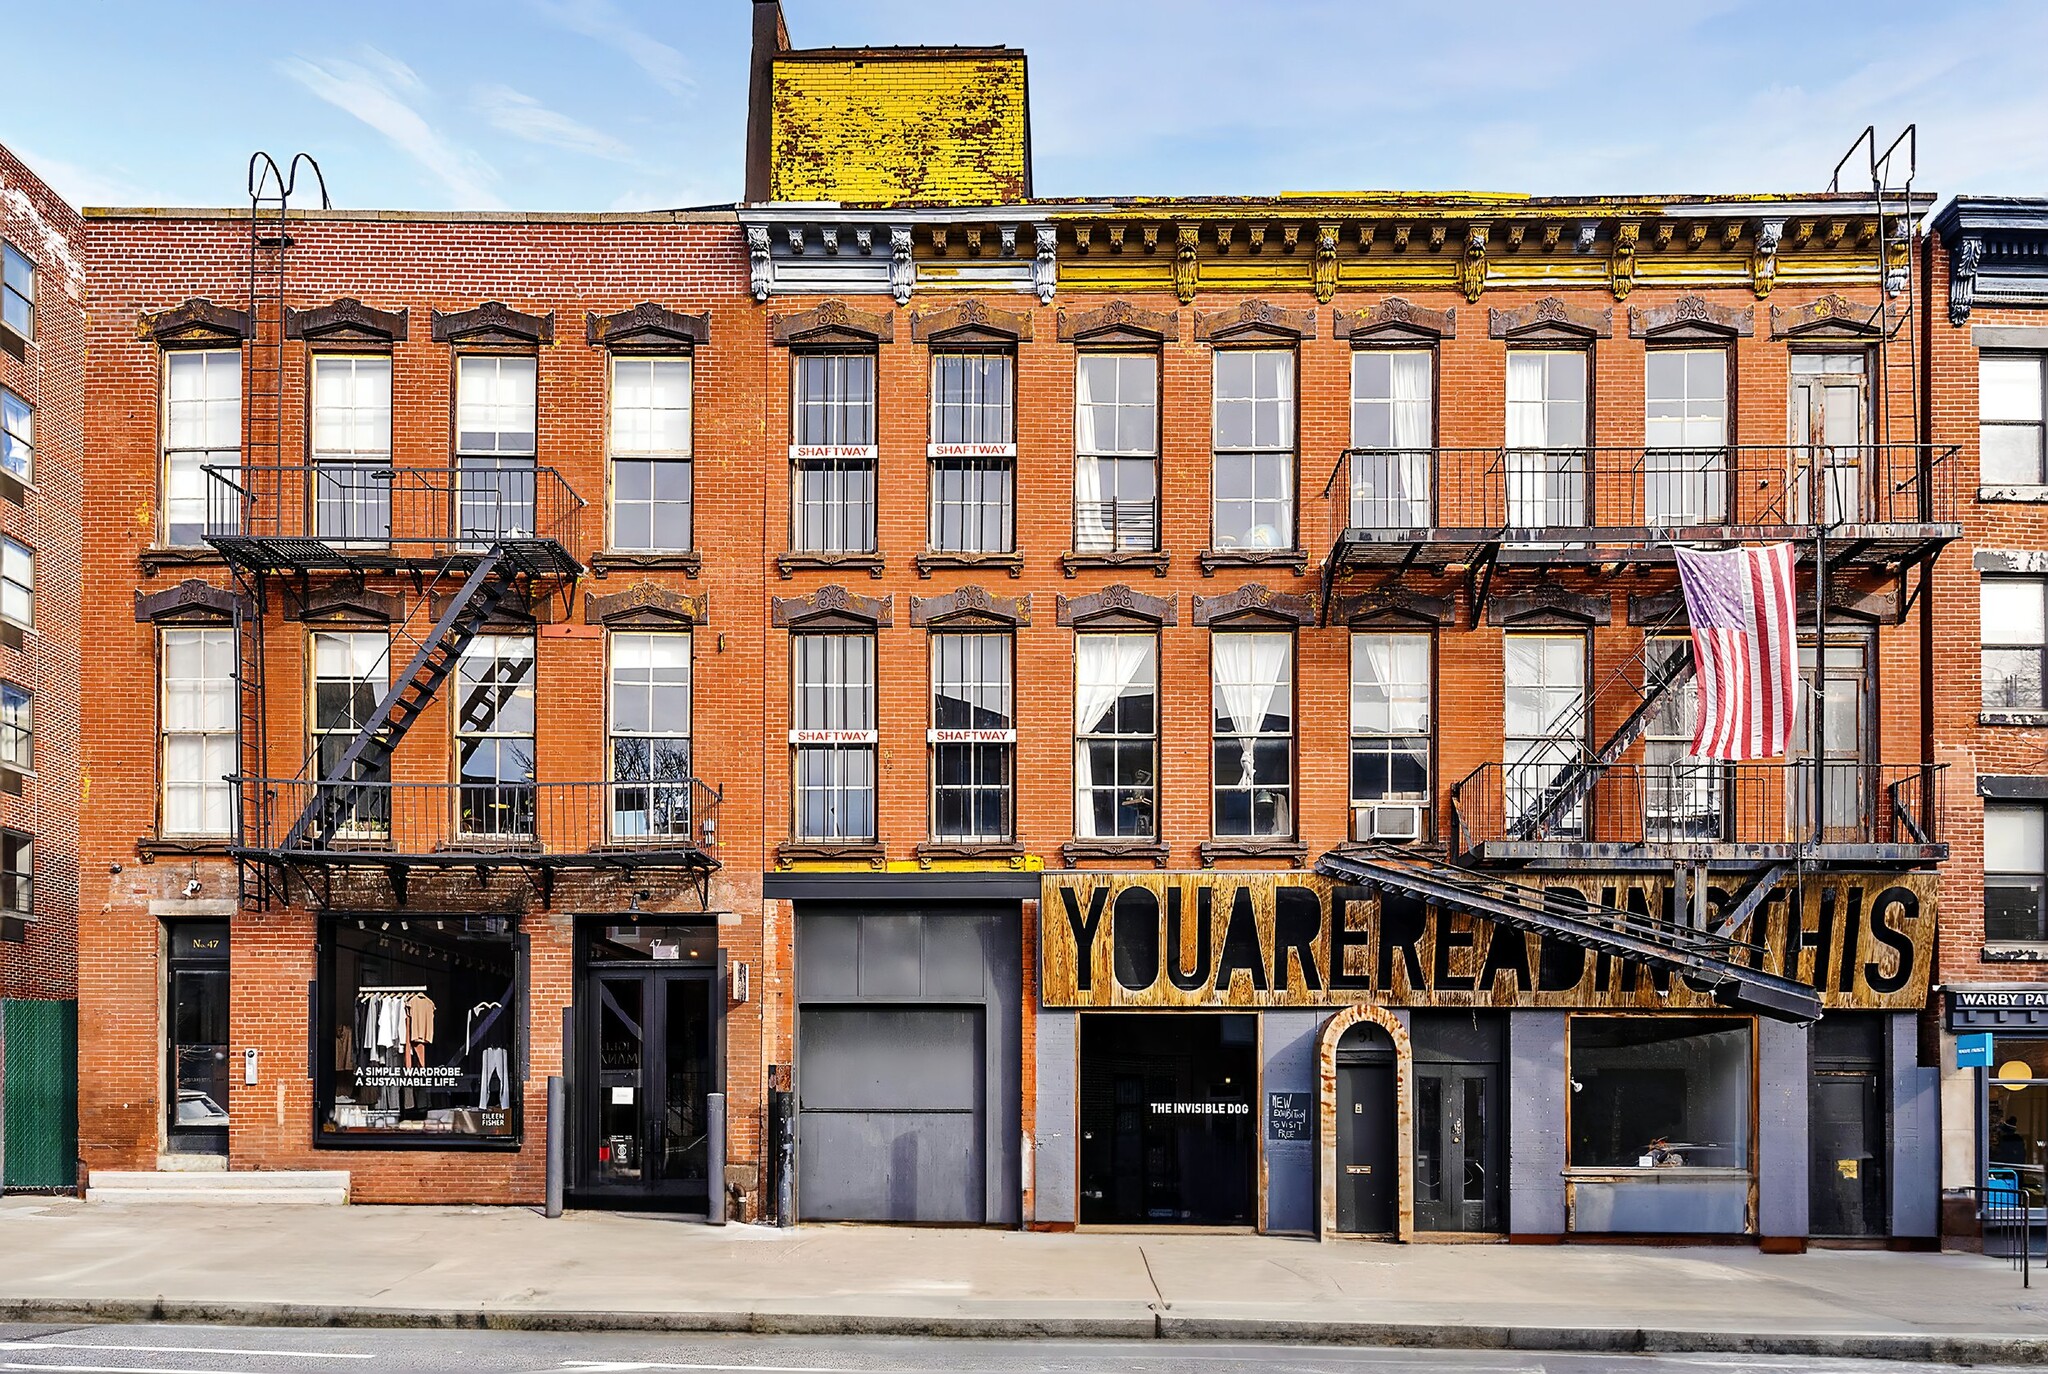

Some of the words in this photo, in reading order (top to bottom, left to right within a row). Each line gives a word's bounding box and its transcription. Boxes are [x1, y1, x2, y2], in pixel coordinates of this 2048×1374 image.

[798, 447, 869, 456] SHAFTWAY
[936, 445, 1007, 454] SHAFTWAY
[798, 731, 869, 741] SHAFTWAY
[936, 731, 1008, 740] SHAFTWAY
[207, 940, 219, 948] 47
[650, 939, 662, 948] 47
[1962, 994, 2018, 1006] WARBY
[2025, 994, 2048, 1006] PA
[1359, 1028, 1374, 1042] 51
[355, 1067, 364, 1076] A
[365, 1067, 401, 1076] SIMPLE
[403, 1067, 464, 1077] WARDROBE.
[355, 1078, 364, 1087] A
[366, 1077, 432, 1087] SUSTAINABLE
[434, 1078, 458, 1087] LIFE.
[1272, 1094, 1293, 1109] NEW
[1151, 1103, 1173, 1114] THE
[1174, 1103, 1226, 1114] INVISIBLE
[1228, 1103, 1249, 1114] DOG
[1278, 1129, 1295, 1139] FREE
